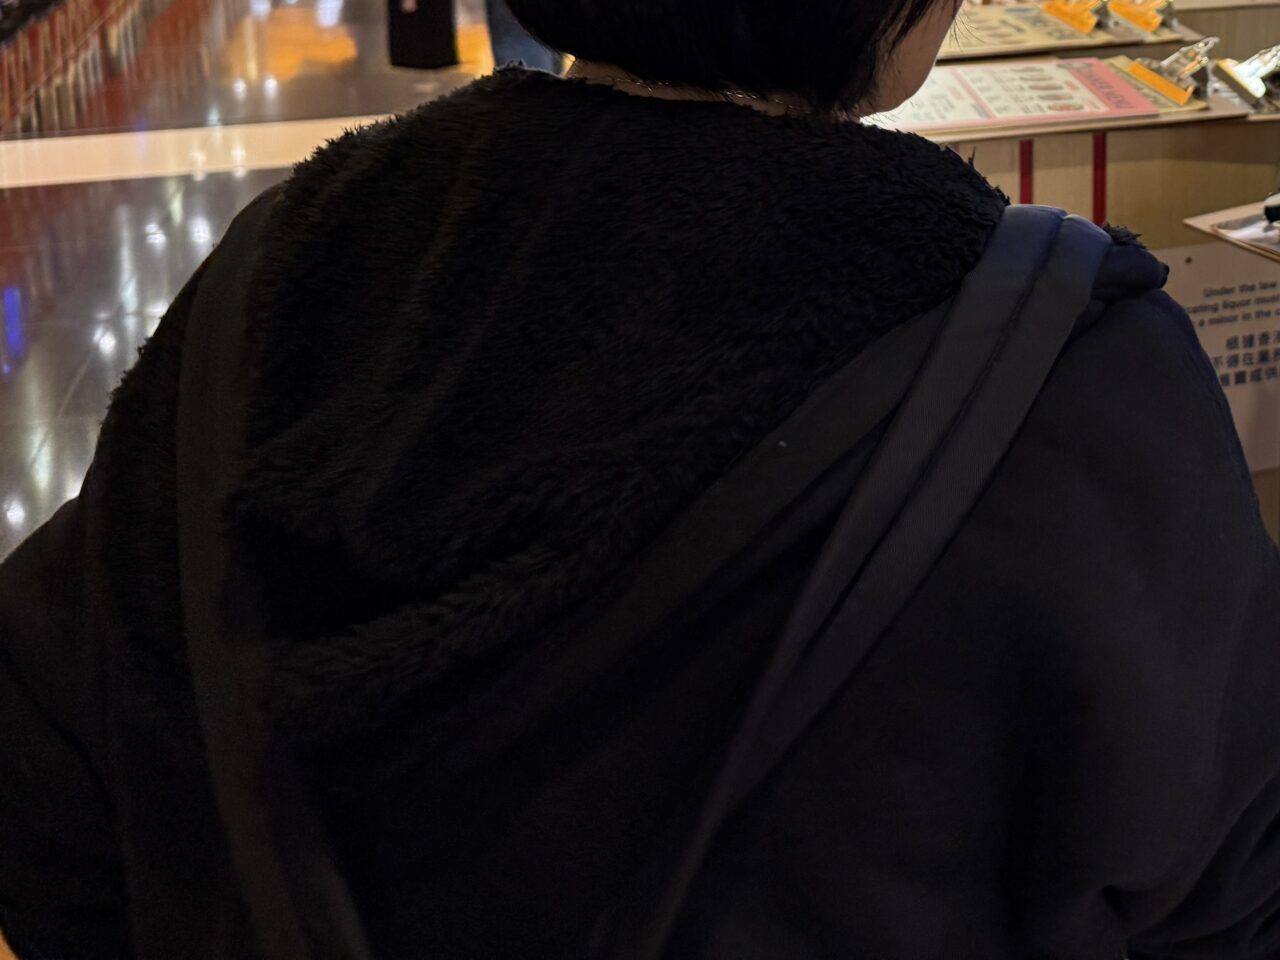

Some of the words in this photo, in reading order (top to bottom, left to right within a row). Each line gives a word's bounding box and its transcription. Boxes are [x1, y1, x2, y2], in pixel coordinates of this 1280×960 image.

[1203, 286, 1235, 297] Under
[1239, 284, 1256, 293] the
[1255, 310, 1272, 319] the
